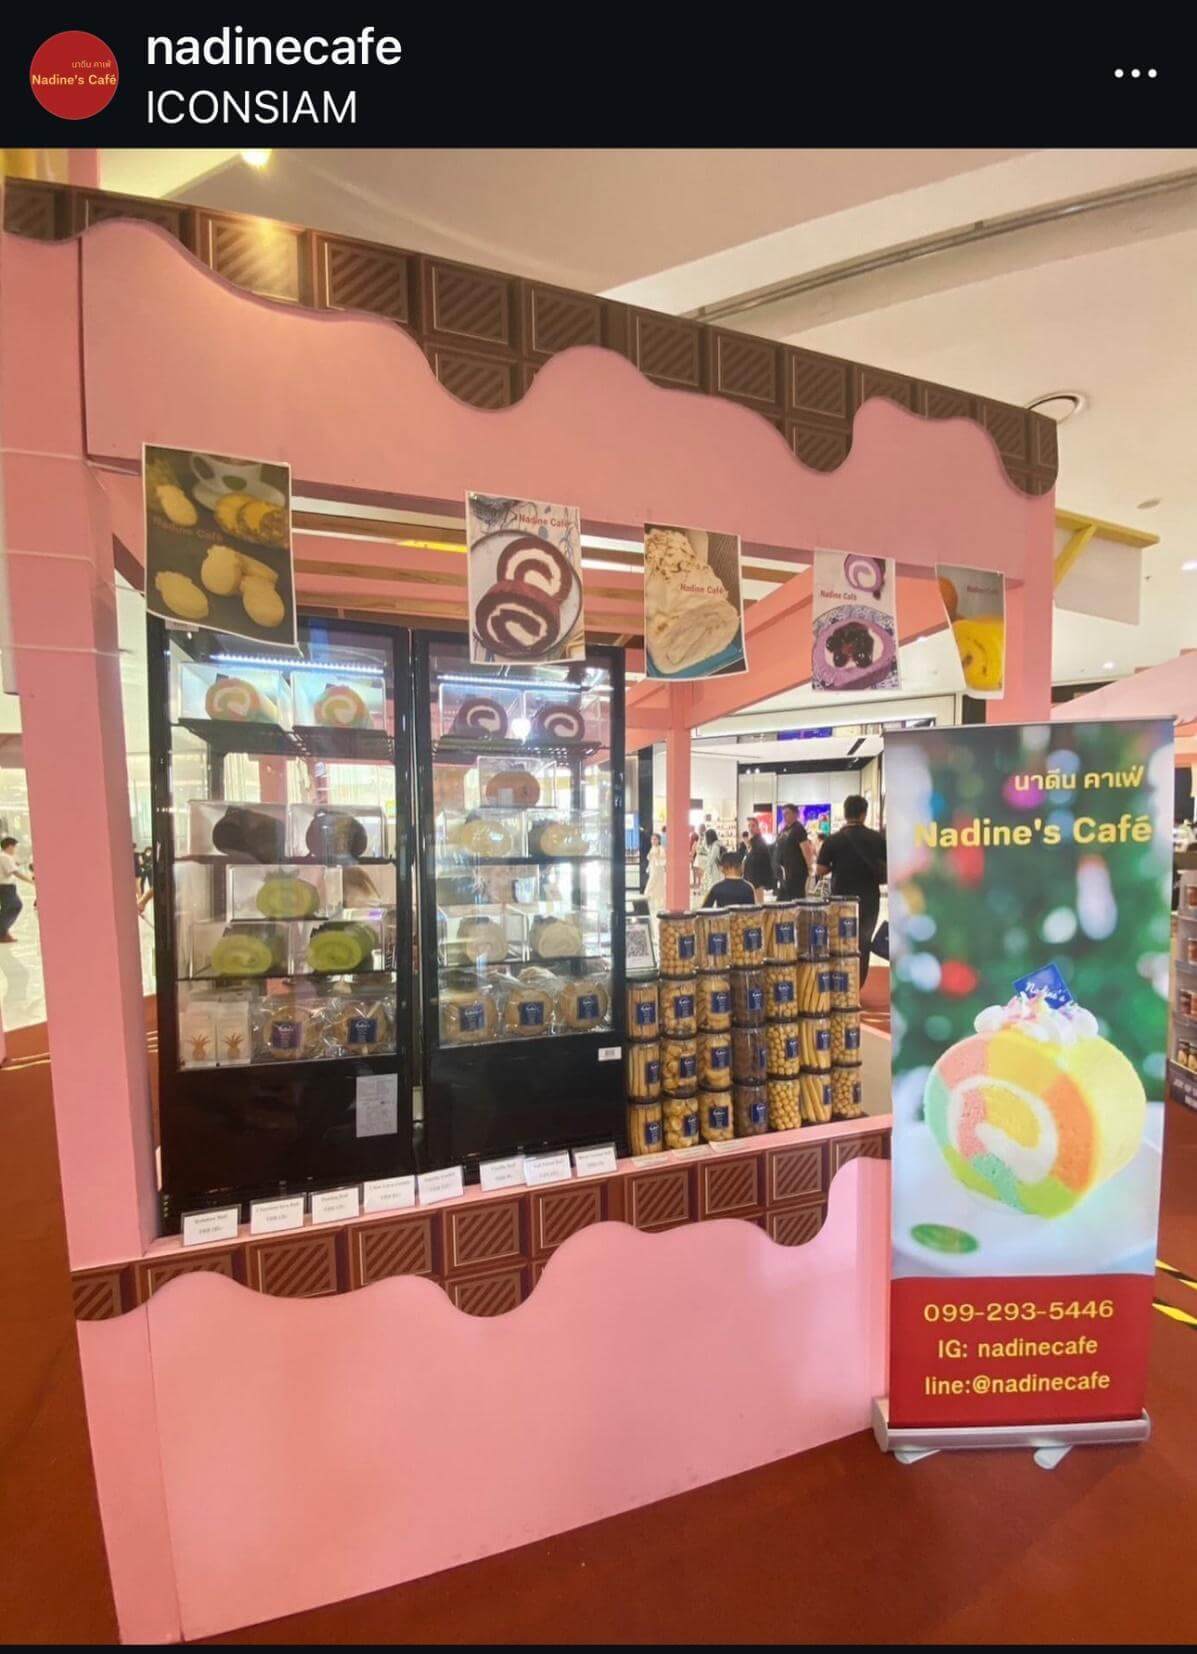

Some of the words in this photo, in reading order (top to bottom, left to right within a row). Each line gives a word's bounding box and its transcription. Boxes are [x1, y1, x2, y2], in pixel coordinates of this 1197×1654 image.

[519, 513, 548, 525] Nadine
[1014, 767, 1076, 791] นาดีน
[1083, 764, 1145, 789] คาเฟ่
[914, 818, 1061, 848] Nadine's
[1073, 814, 1153, 844] Café
[923, 1300, 1114, 1322] 099-293-5446
[938, 1339, 968, 1359] IG:
[977, 1336, 1099, 1358] nadinecafe
[925, 1371, 1111, 1396] line:@nadinecafe
